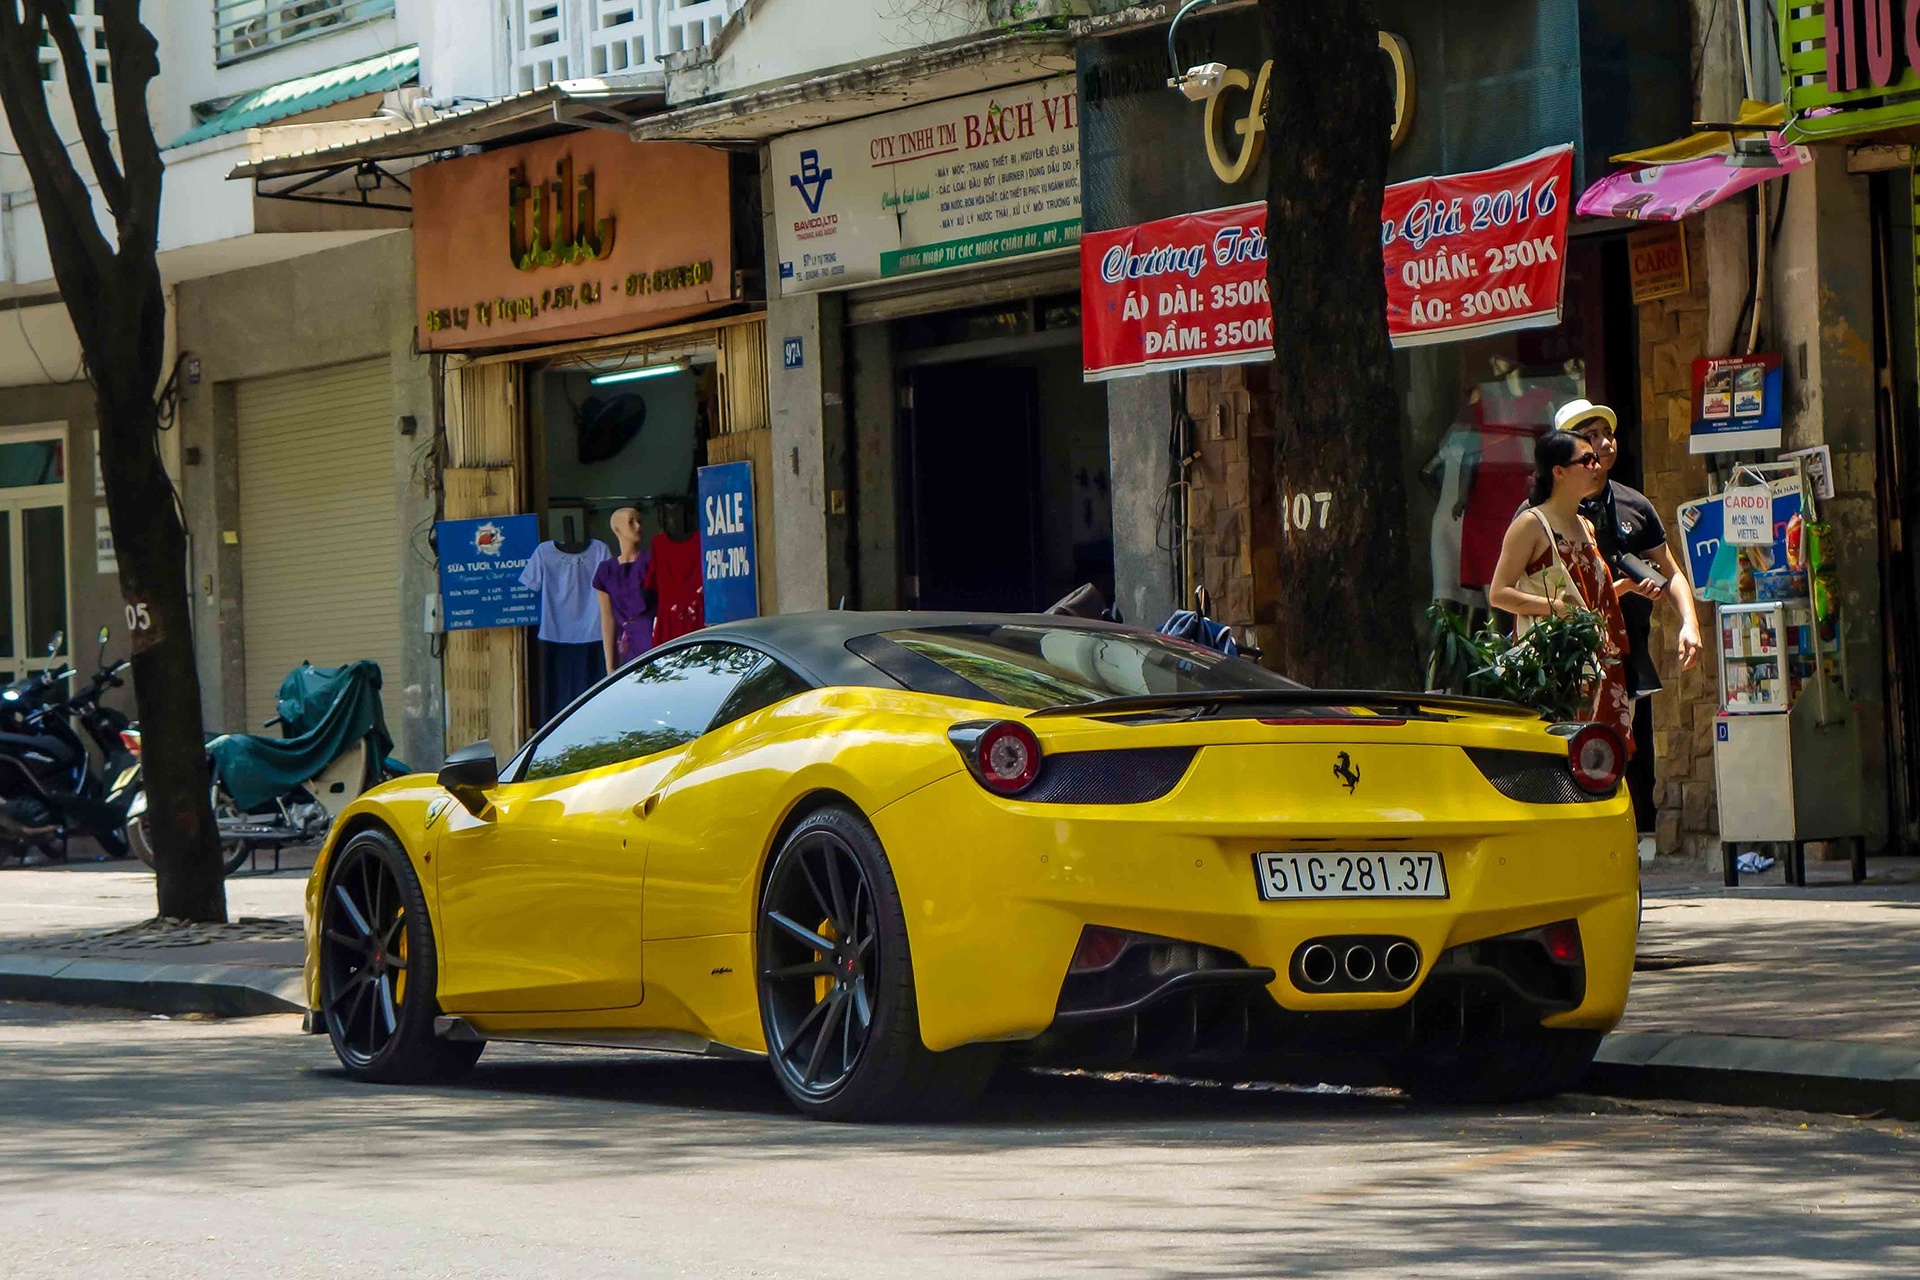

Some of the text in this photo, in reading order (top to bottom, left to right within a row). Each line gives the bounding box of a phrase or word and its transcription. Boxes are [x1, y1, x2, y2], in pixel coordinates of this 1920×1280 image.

[870, 135, 895, 160] CTY
[898, 126, 934, 154] TNHH
[937, 122, 957, 146] TM
[963, 100, 1034, 149] BÁCH
[969, 160, 990, 172] TRANG
[1020, 148, 1044, 161] NGUYÊN
[1101, 242, 1208, 284] Chương
[1398, 197, 1466, 250] Giá
[1471, 175, 1559, 232] 2016
[1402, 235, 1558, 289] QUẦN: 250K
[1158, 284, 1204, 316] DÀI:
[1210, 278, 1270, 310] 350K
[1410, 283, 1533, 325] ÁO: 300K
[1146, 317, 1274, 354] ĐẦM: 350K
[705, 492, 745, 537] SALE
[1751, 515, 1765, 525] VINA
[1737, 529, 1759, 539] VIETTEL
[1266, 857, 1433, 892] 51G-281.37
